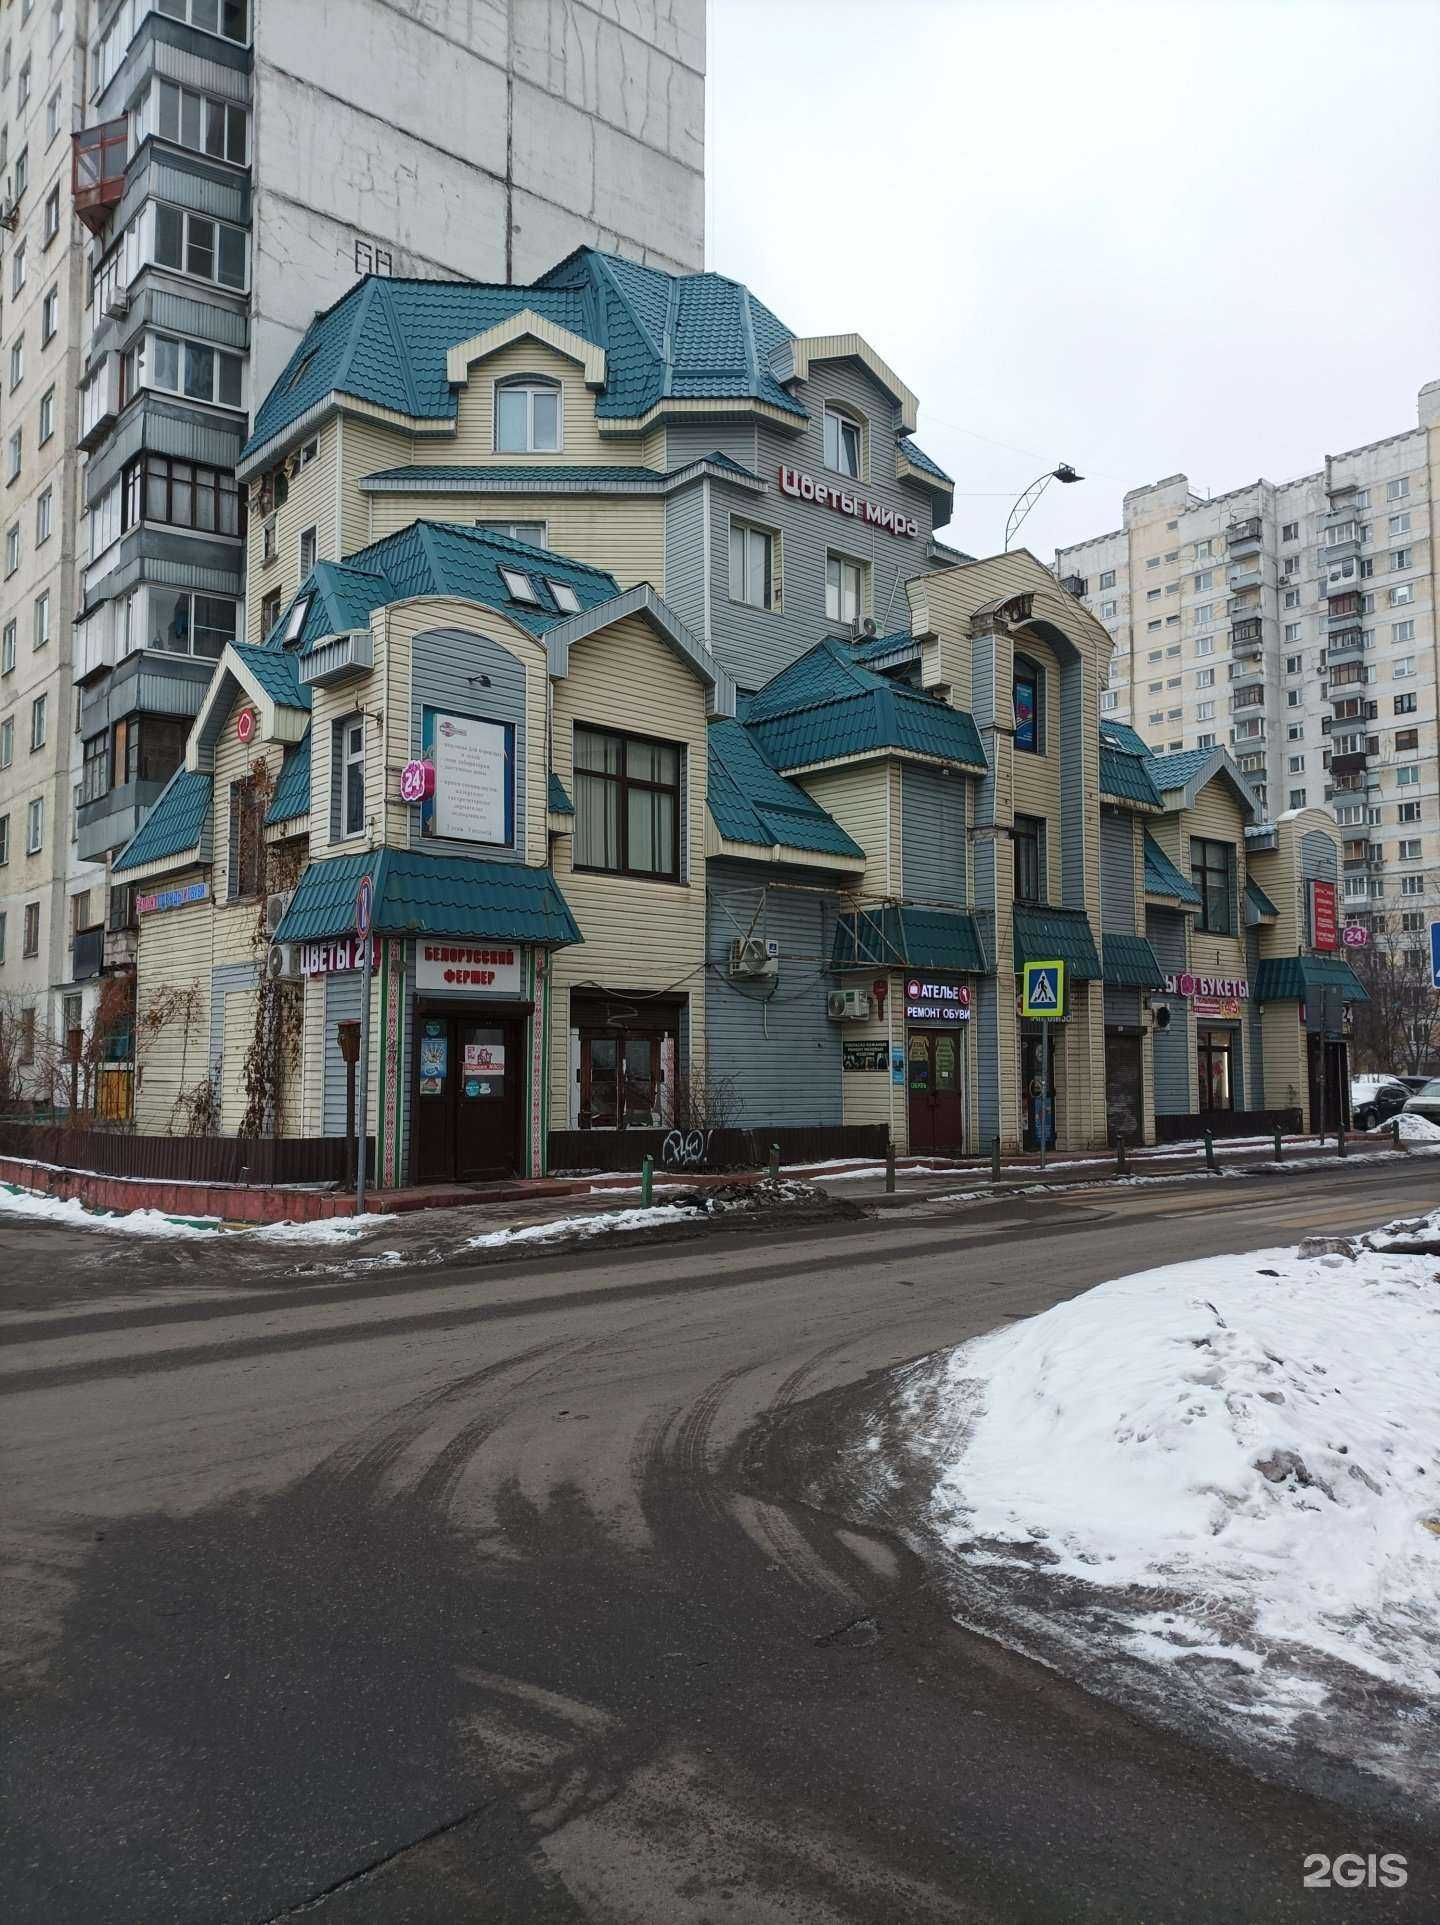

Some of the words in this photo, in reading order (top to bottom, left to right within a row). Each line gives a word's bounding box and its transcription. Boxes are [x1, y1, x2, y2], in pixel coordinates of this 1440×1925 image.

[779, 465, 858, 516] Цветы
[864, 500, 919, 537] мира
[405, 770, 420, 793] 24
[1346, 931, 1362, 942] 24
[300, 940, 350, 977] ЦВЕТЫ
[354, 937, 375, 968] 2
[425, 946, 514, 965] БЕЛОРУССКИЙ
[444, 969, 496, 985] ФЕРМЕР
[921, 984, 959, 1000] АТЕЛЬЕ
[1201, 978, 1249, 997] БУКЕТЫ
[907, 1006, 940, 1018] РЕМОНТ
[943, 1008, 970, 1019] ОБУВИ
